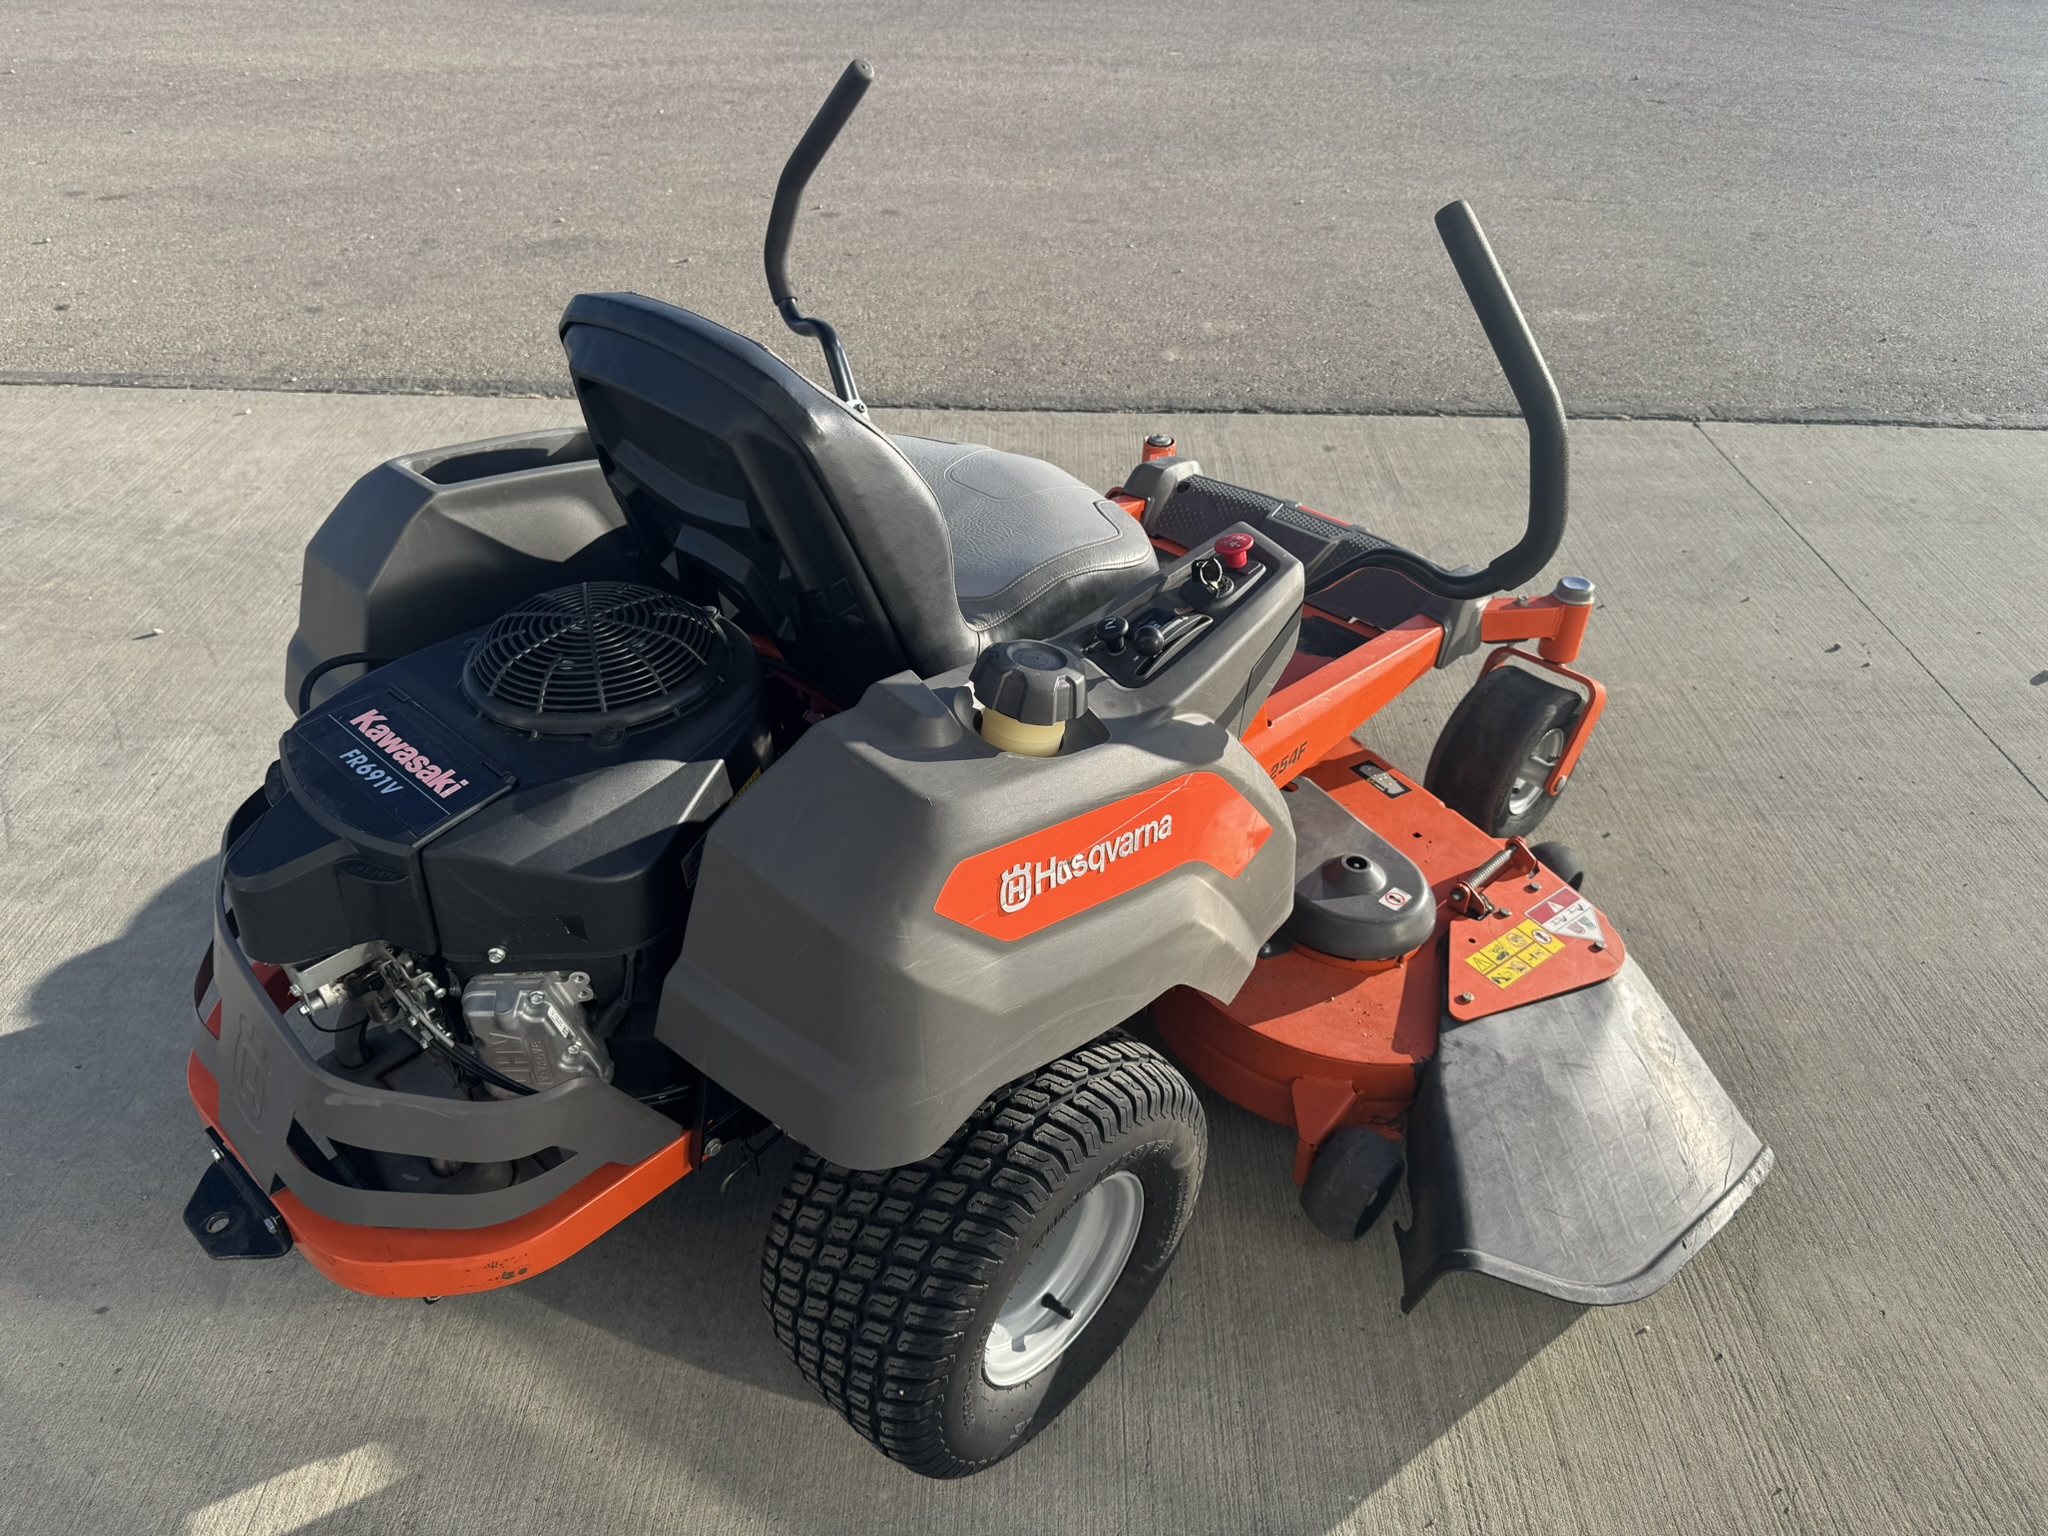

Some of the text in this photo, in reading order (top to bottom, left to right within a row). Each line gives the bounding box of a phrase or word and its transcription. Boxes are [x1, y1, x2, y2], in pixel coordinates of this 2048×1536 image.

[339, 748, 404, 794] FR691V
[349, 708, 470, 799] Kawasaki
[1035, 814, 1173, 896] Husqvarna
